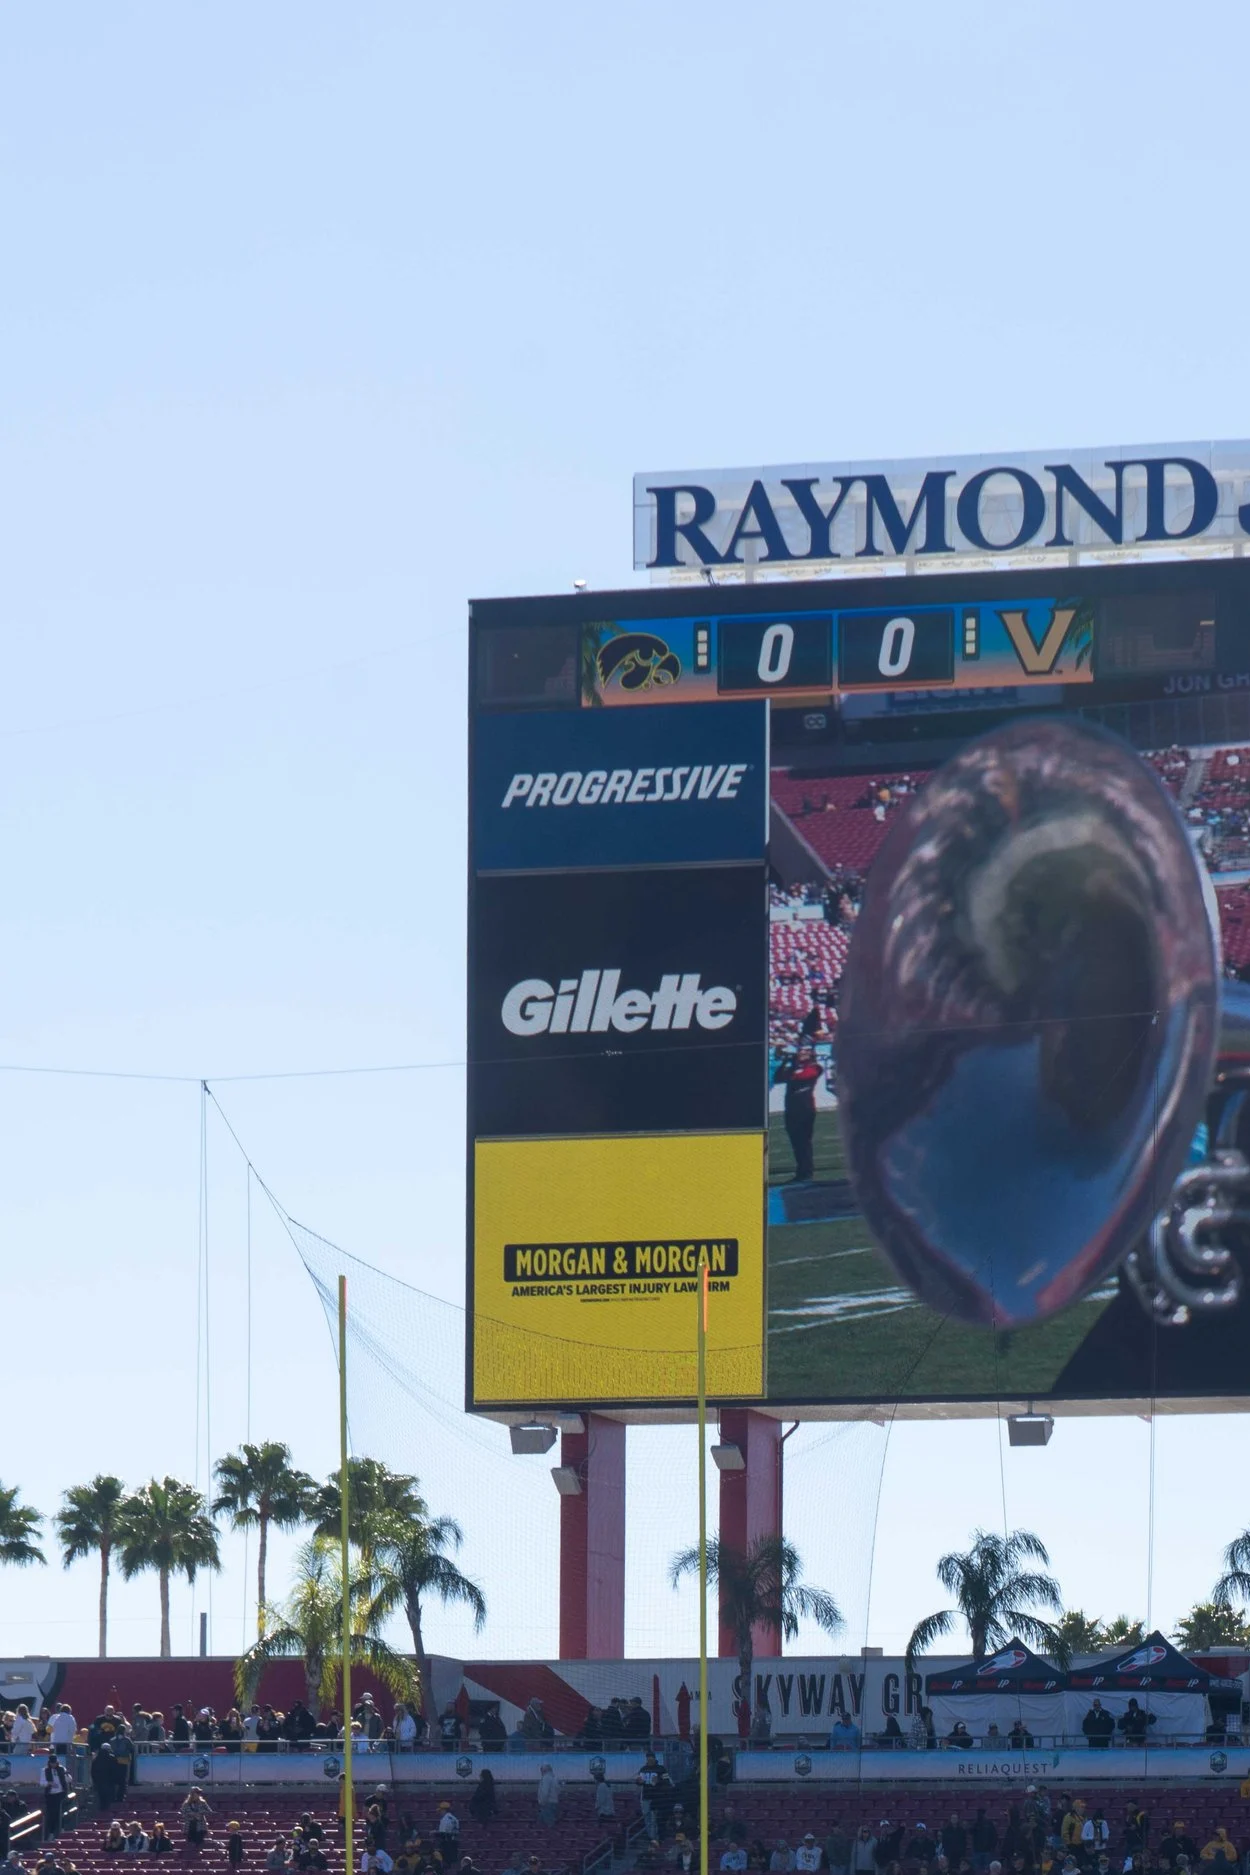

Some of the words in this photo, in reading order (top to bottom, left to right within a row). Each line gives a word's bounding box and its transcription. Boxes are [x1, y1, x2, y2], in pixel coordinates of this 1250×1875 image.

[645, 457, 1218, 568] RAYMOND
[757, 623, 794, 683] 0
[878, 617, 915, 677] 0
[502, 764, 748, 809] PROGRESSIVE
[501, 969, 737, 1036] Gillette
[516, 1247, 606, 1277] MORGAN
[612, 1246, 628, 1275] &
[635, 1243, 726, 1274] MORGAN
[511, 1285, 574, 1297] AMERICA'S
[576, 1283, 626, 1295] LARGEST
[629, 1282, 671, 1294] INJURY
[673, 1281, 698, 1293] LAW
[705, 1281, 730, 1292] IRM
[957, 1763, 1048, 1775] RELIAQUEST
